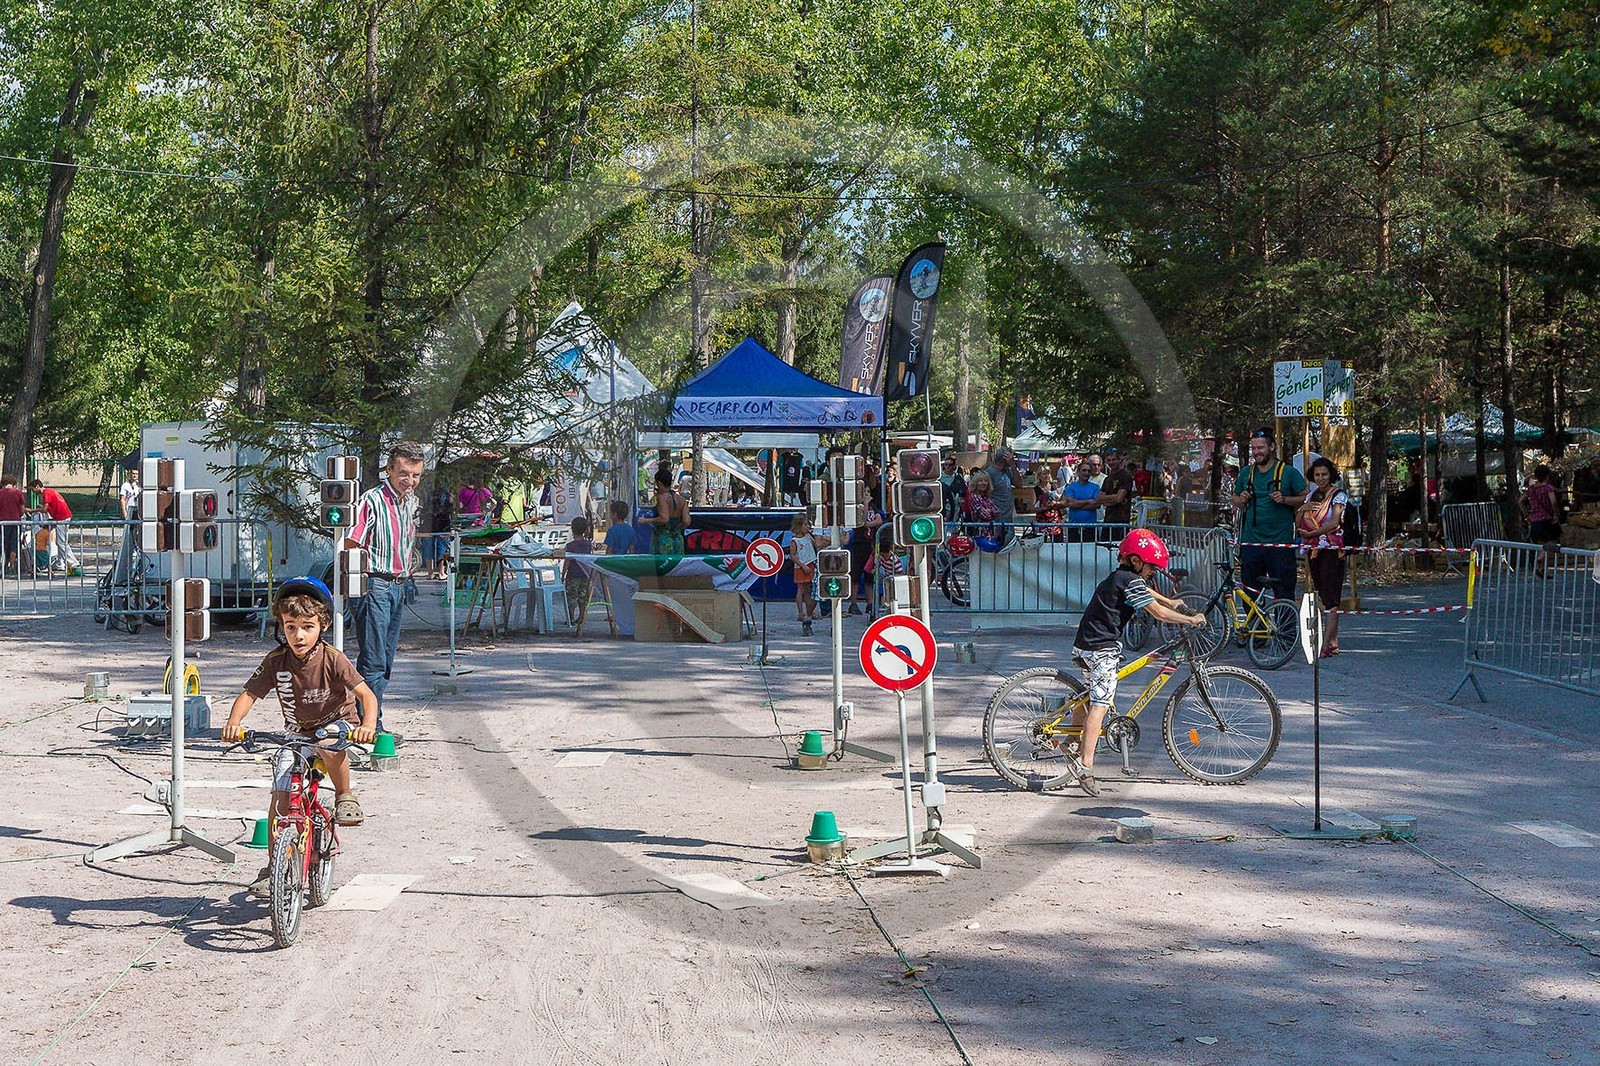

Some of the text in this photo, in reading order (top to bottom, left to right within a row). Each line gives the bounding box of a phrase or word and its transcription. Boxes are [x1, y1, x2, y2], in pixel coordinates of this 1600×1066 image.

[908, 300, 923, 363] SKYVER
[861, 323, 875, 380] SKYVER
[1276, 369, 1322, 400] Génépi
[690, 400, 774, 416] DESARP.COM
[1276, 401, 1323, 416] Foire Bio
